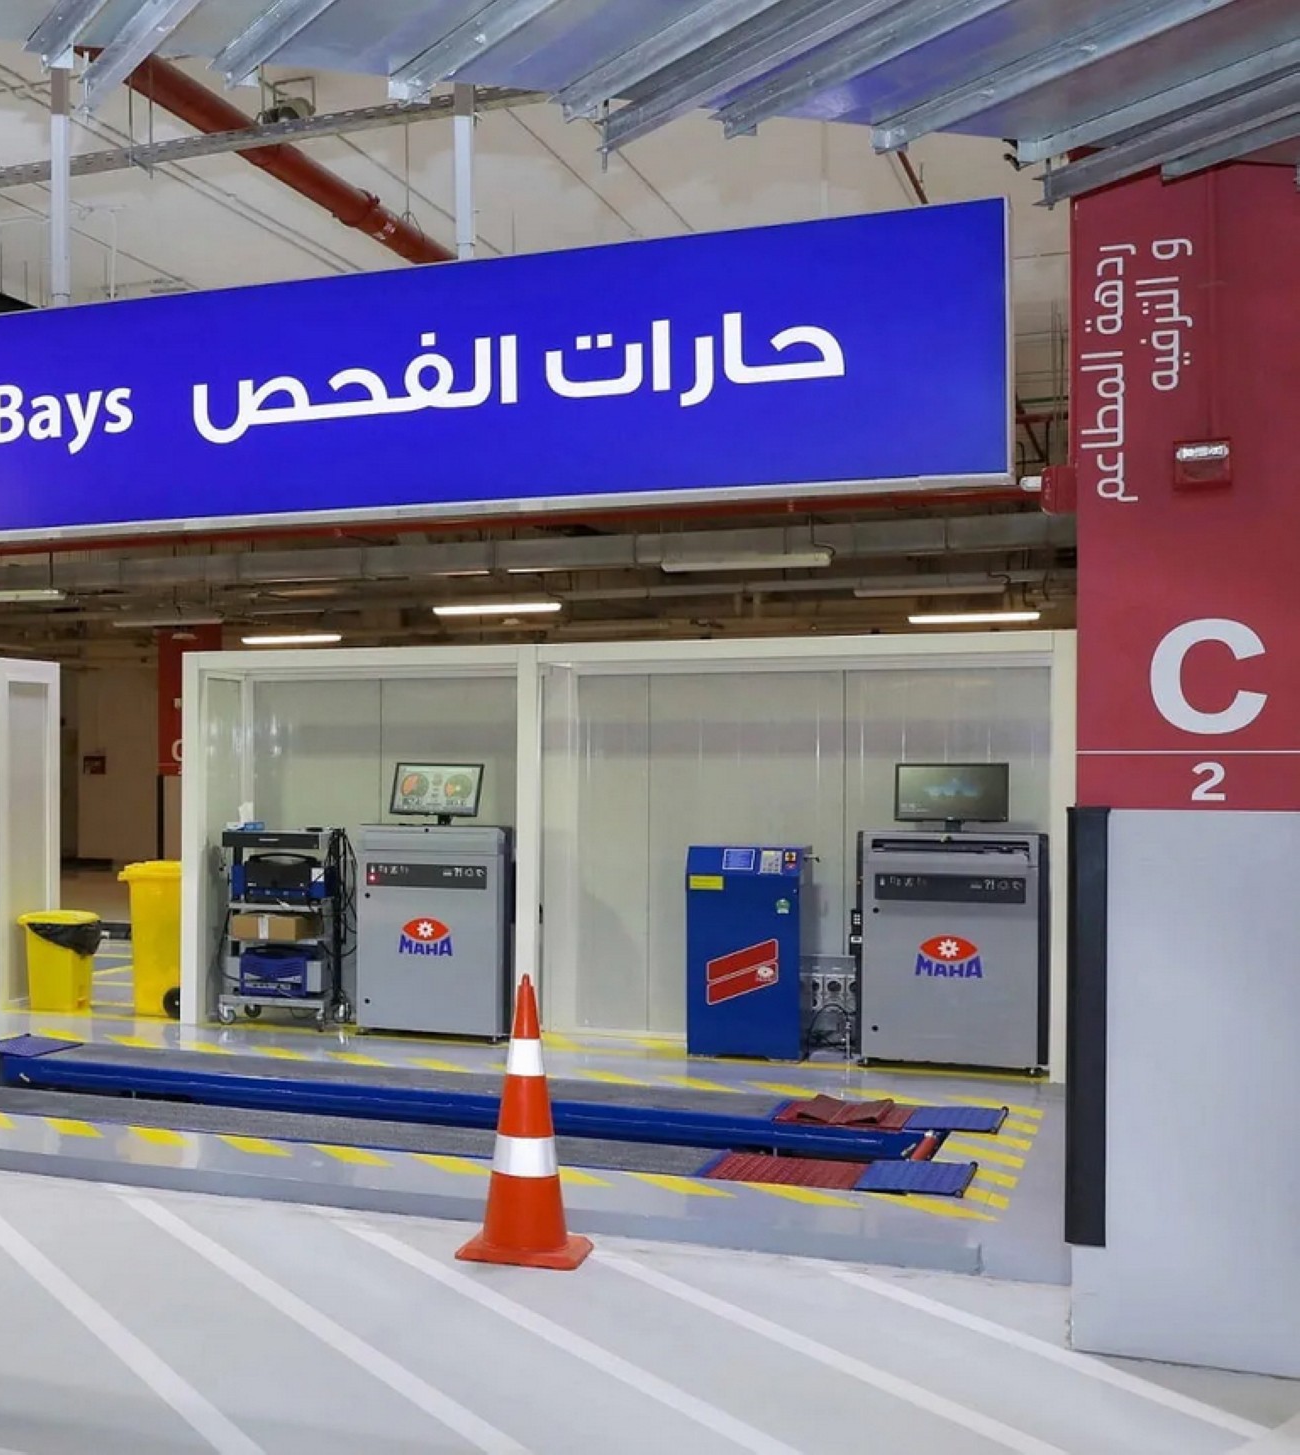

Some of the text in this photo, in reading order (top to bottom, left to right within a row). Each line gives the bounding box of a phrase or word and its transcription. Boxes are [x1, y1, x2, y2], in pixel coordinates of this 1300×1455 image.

[1080, 243, 1139, 503] ردهة المطاعم
[1135, 238, 1193, 391] و الترفيه
[192, 311, 847, 445] حارات الفحص
[1149, 617, 1268, 735] C
[1191, 761, 1227, 801] 2
[398, 933, 453, 957] MAHA
[914, 952, 984, 979] MAHA
